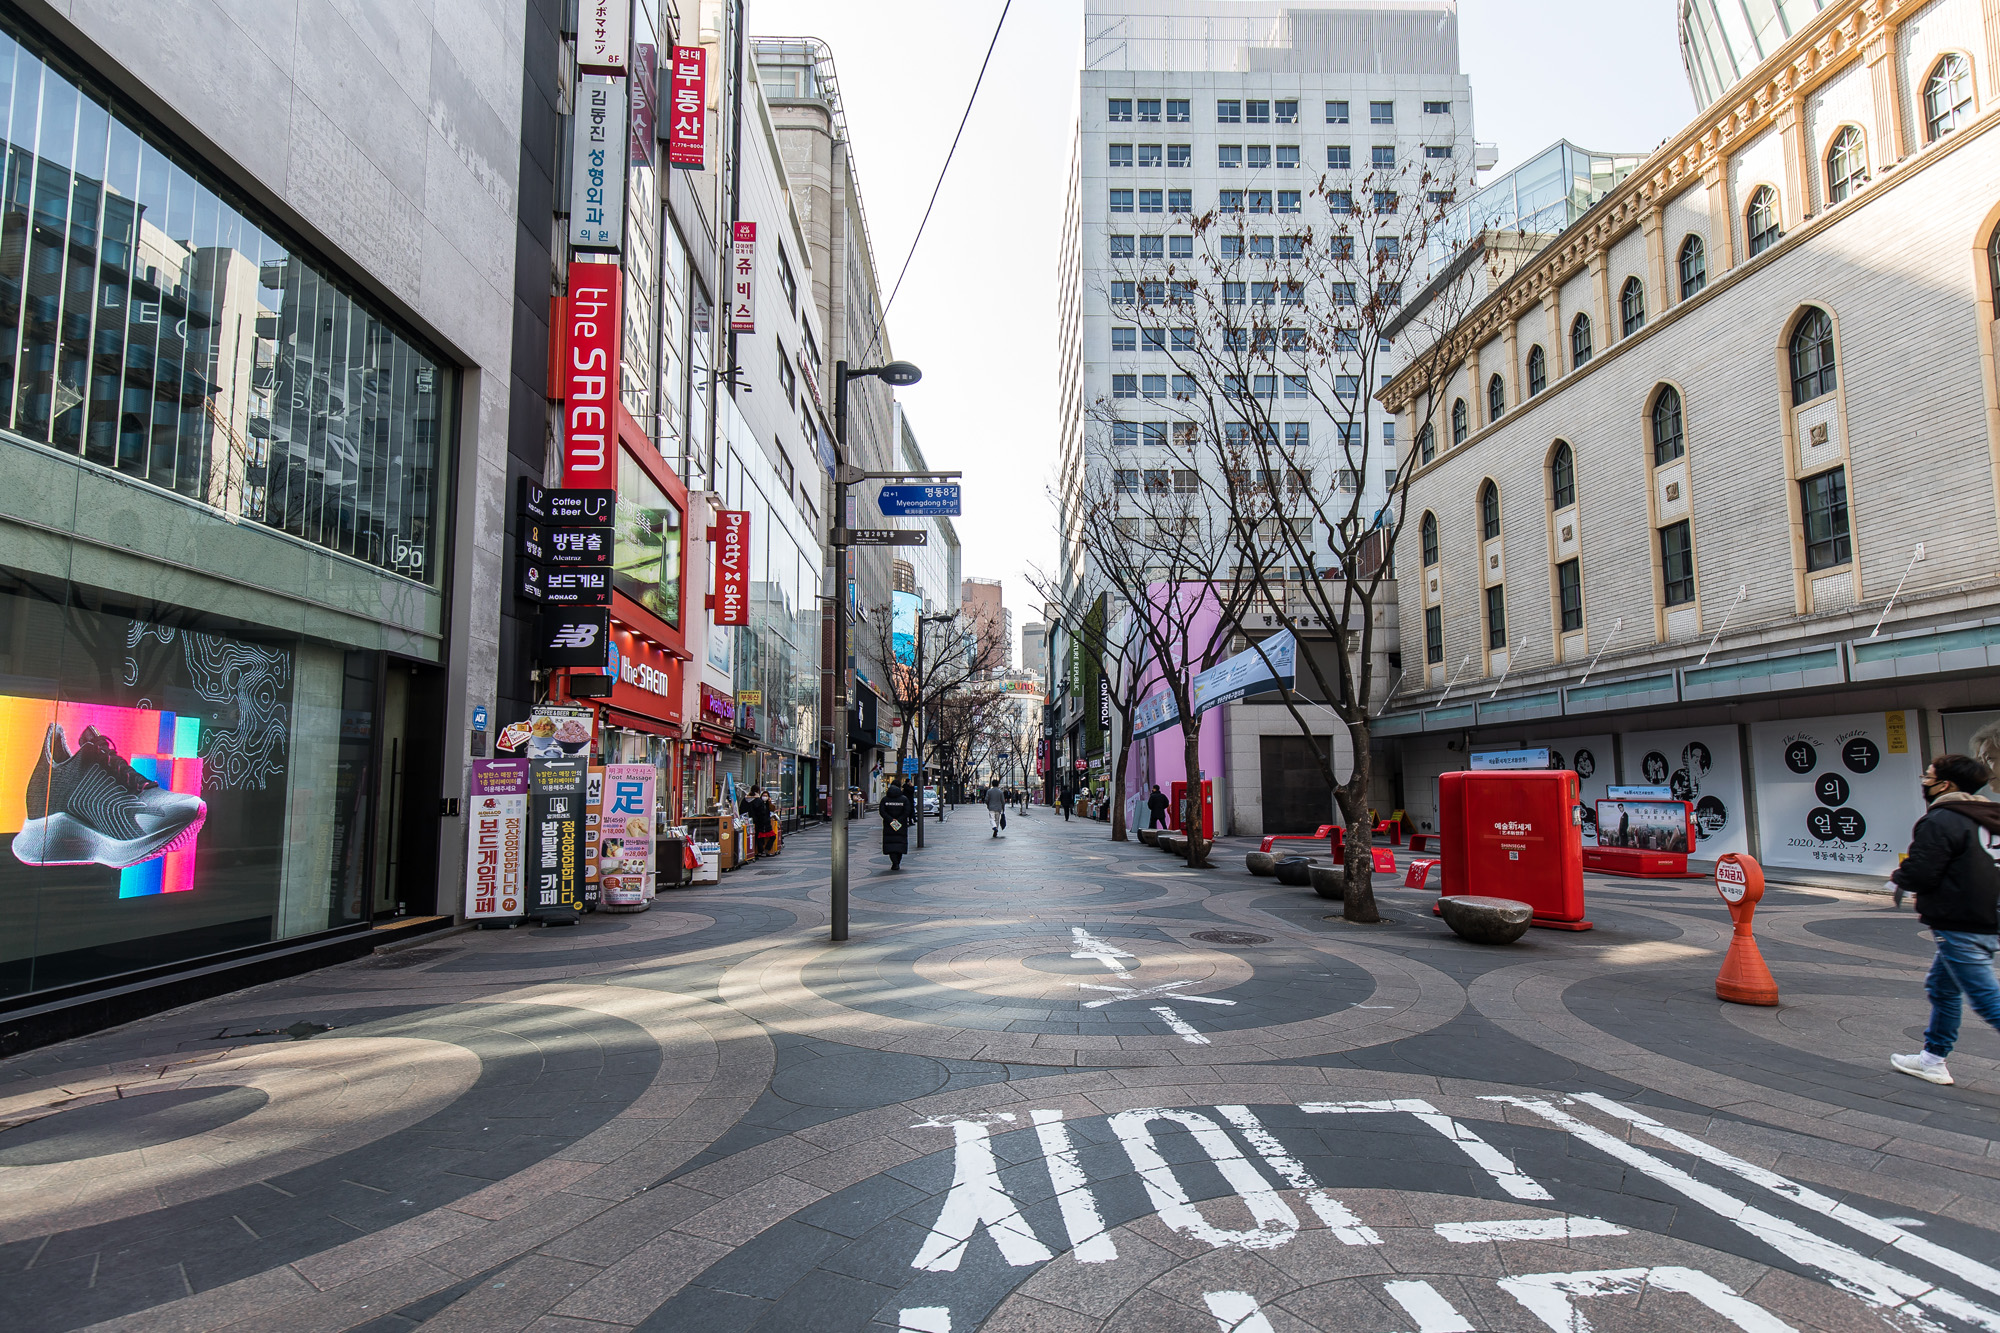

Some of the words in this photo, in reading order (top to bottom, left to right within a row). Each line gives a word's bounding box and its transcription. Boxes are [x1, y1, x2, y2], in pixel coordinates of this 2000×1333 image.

[608, 55, 619, 63] 8F
[679, 49, 700, 60] 현대
[675, 63, 701, 139] 부동산
[590, 90, 606, 142] 김동진
[586, 149, 604, 225] 성형외과
[736, 258, 752, 317] 쥬비스
[575, 287, 608, 338] the
[552, 497, 582, 506] Coffee
[925, 487, 958, 498] 명동8길
[561, 508, 581, 516] Beer
[942, 499, 958, 507] 8-gil
[552, 533, 602, 551] 방탈출
[722, 513, 742, 570] Pretty
[548, 574, 605, 588] 보드게임
[724, 584, 741, 621] skin
[999, 681, 1034, 694] young
[475, 713, 485, 723] ADT
[1782, 732, 1796, 747] The
[1797, 731, 1814, 741] face
[1812, 739, 1824, 748] of
[1834, 729, 1868, 747] Theater
[610, 782, 645, 814] 足
[541, 821, 559, 868] 방탈출
[1787, 838, 1816, 848] 2020.
[475, 818, 499, 913] 보드게임카페
[503, 818, 520, 895] 정상영업합니다
[561, 820, 575, 904] 정상영업합니다
[1812, 851, 1864, 863] 명동예술극장
[1719, 868, 1743, 882] 주차금지
[540, 873, 559, 905] 카페
[505, 901, 514, 909] 7F
